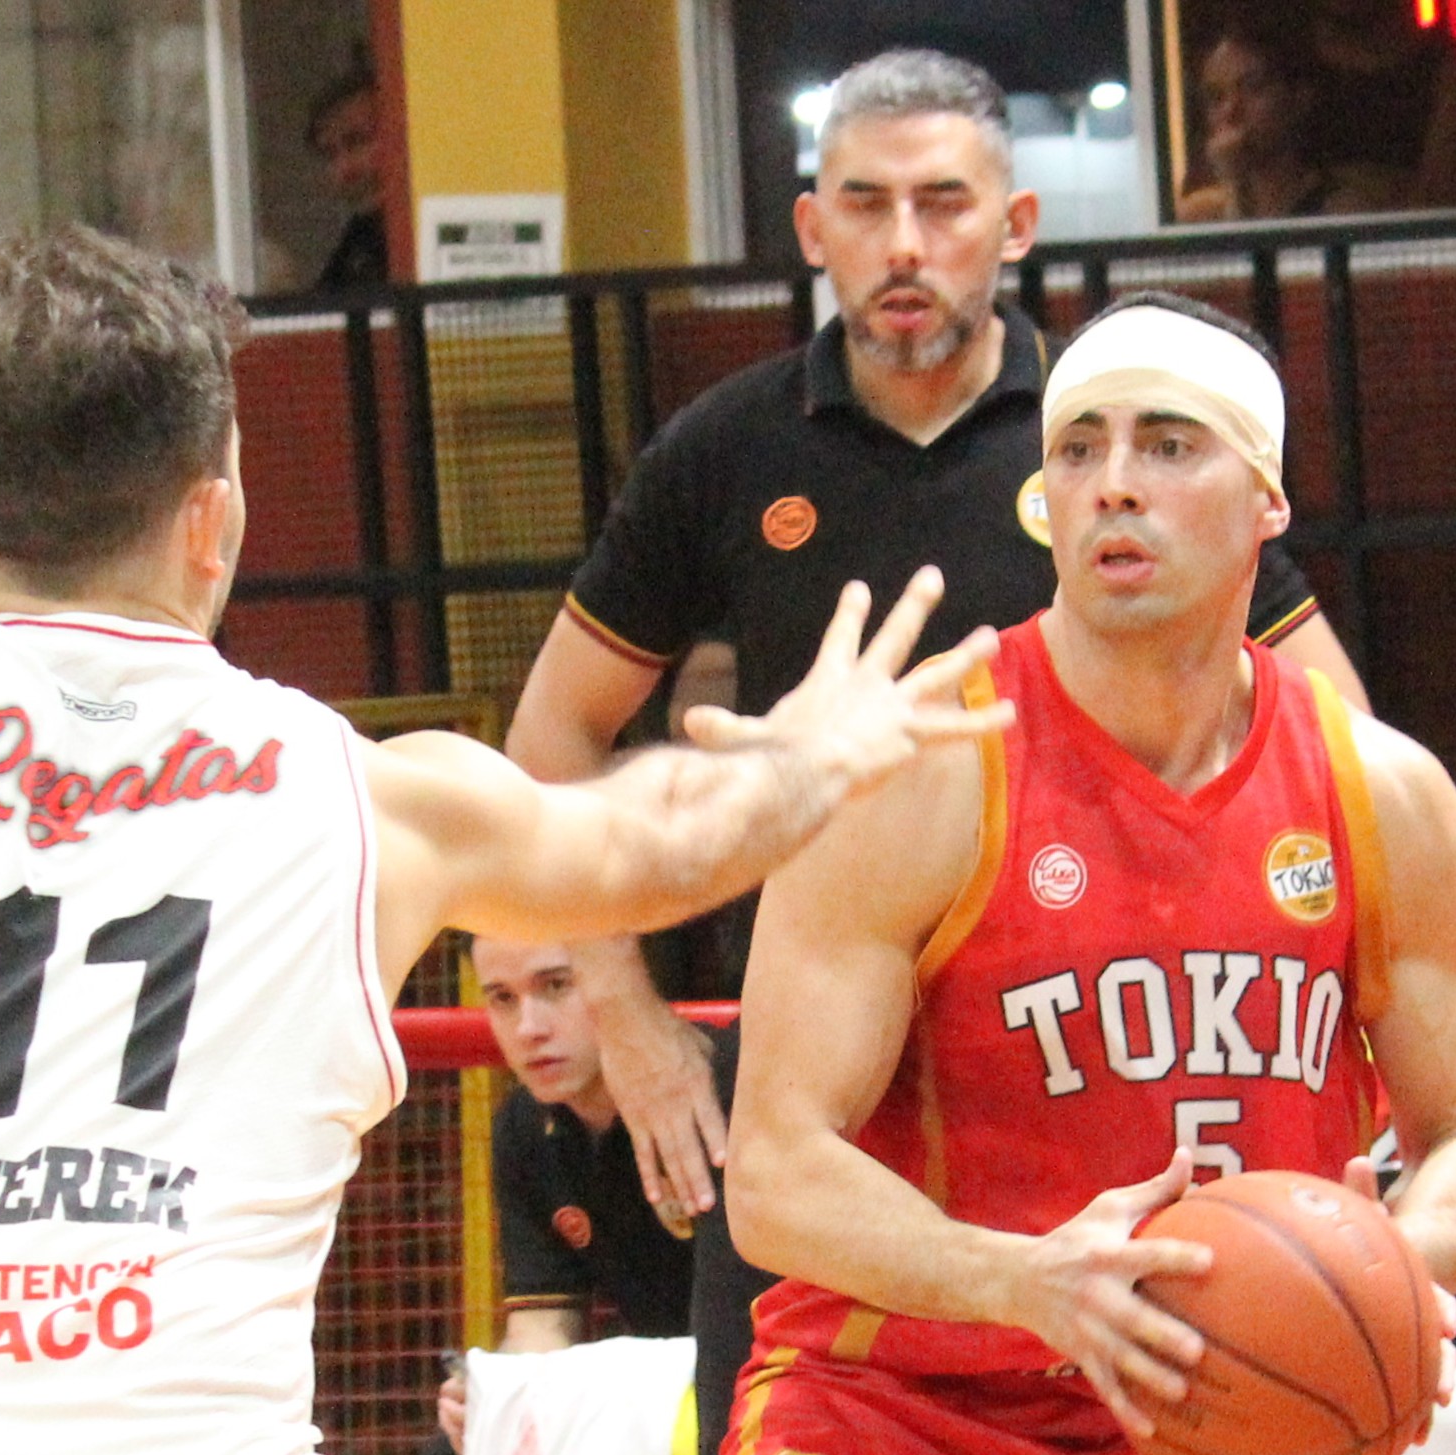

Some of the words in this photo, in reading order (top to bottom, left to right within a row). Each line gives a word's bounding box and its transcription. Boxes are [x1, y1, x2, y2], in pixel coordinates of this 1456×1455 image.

[1274, 859, 1334, 899] TOKIO
[1000, 949, 1344, 1097] TOKIO
[1174, 1098, 1243, 1190] 5
